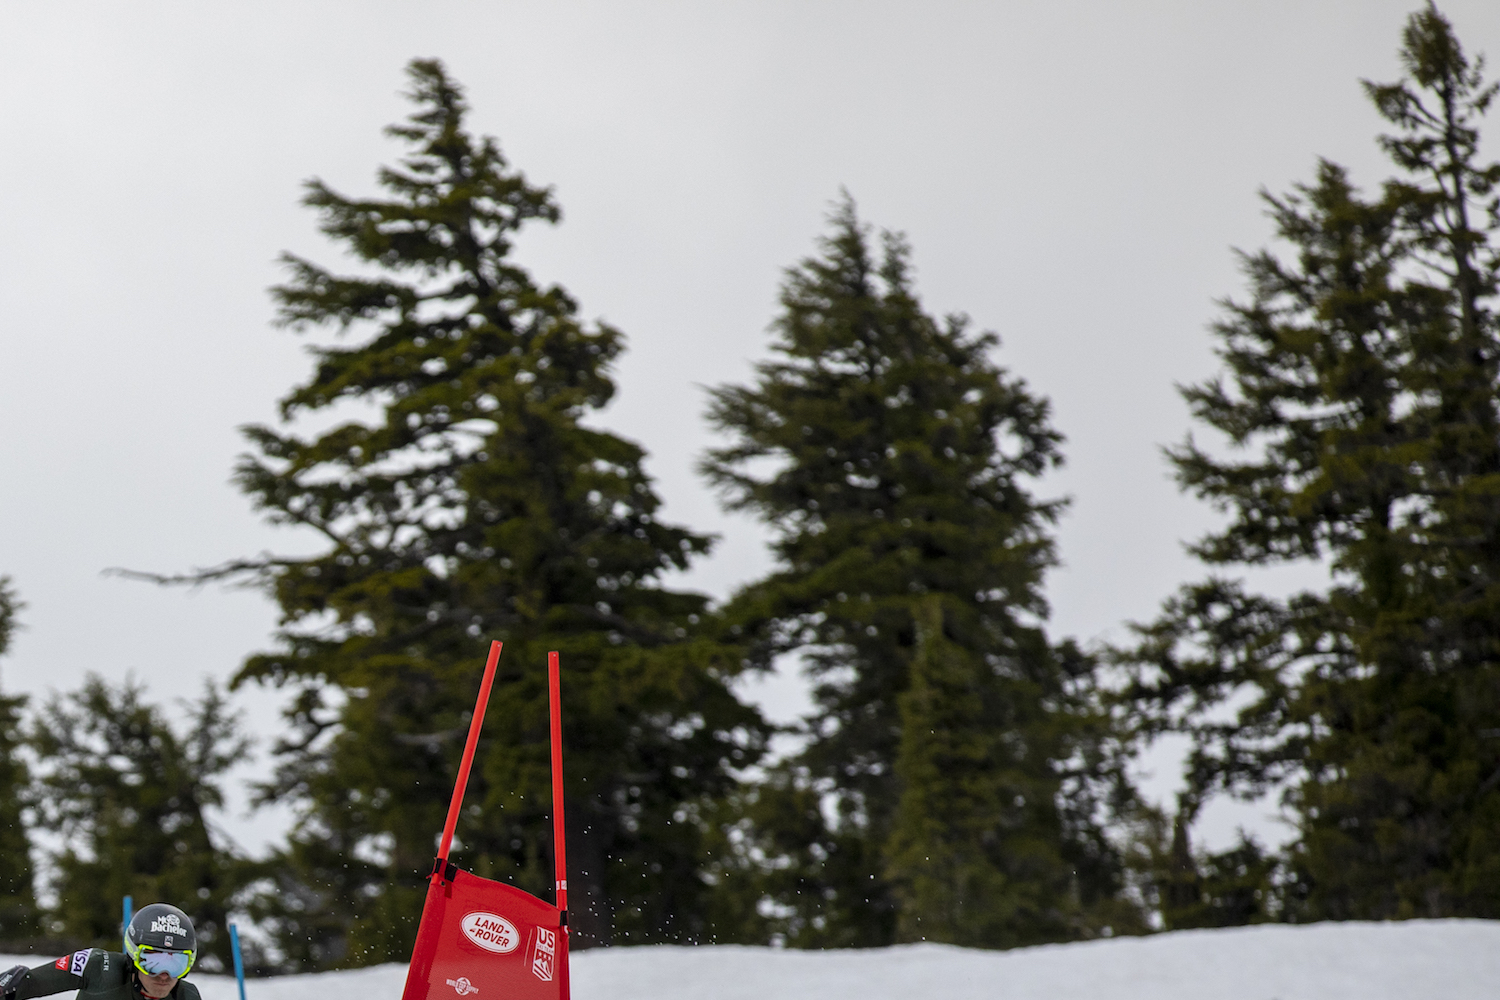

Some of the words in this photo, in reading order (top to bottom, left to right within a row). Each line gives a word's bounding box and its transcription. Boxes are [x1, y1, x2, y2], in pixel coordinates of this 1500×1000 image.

[150, 921, 187, 938] Bachelor
[474, 917, 505, 934] LAND
[474, 929, 510, 948] ROVER
[538, 927, 554, 949] US
